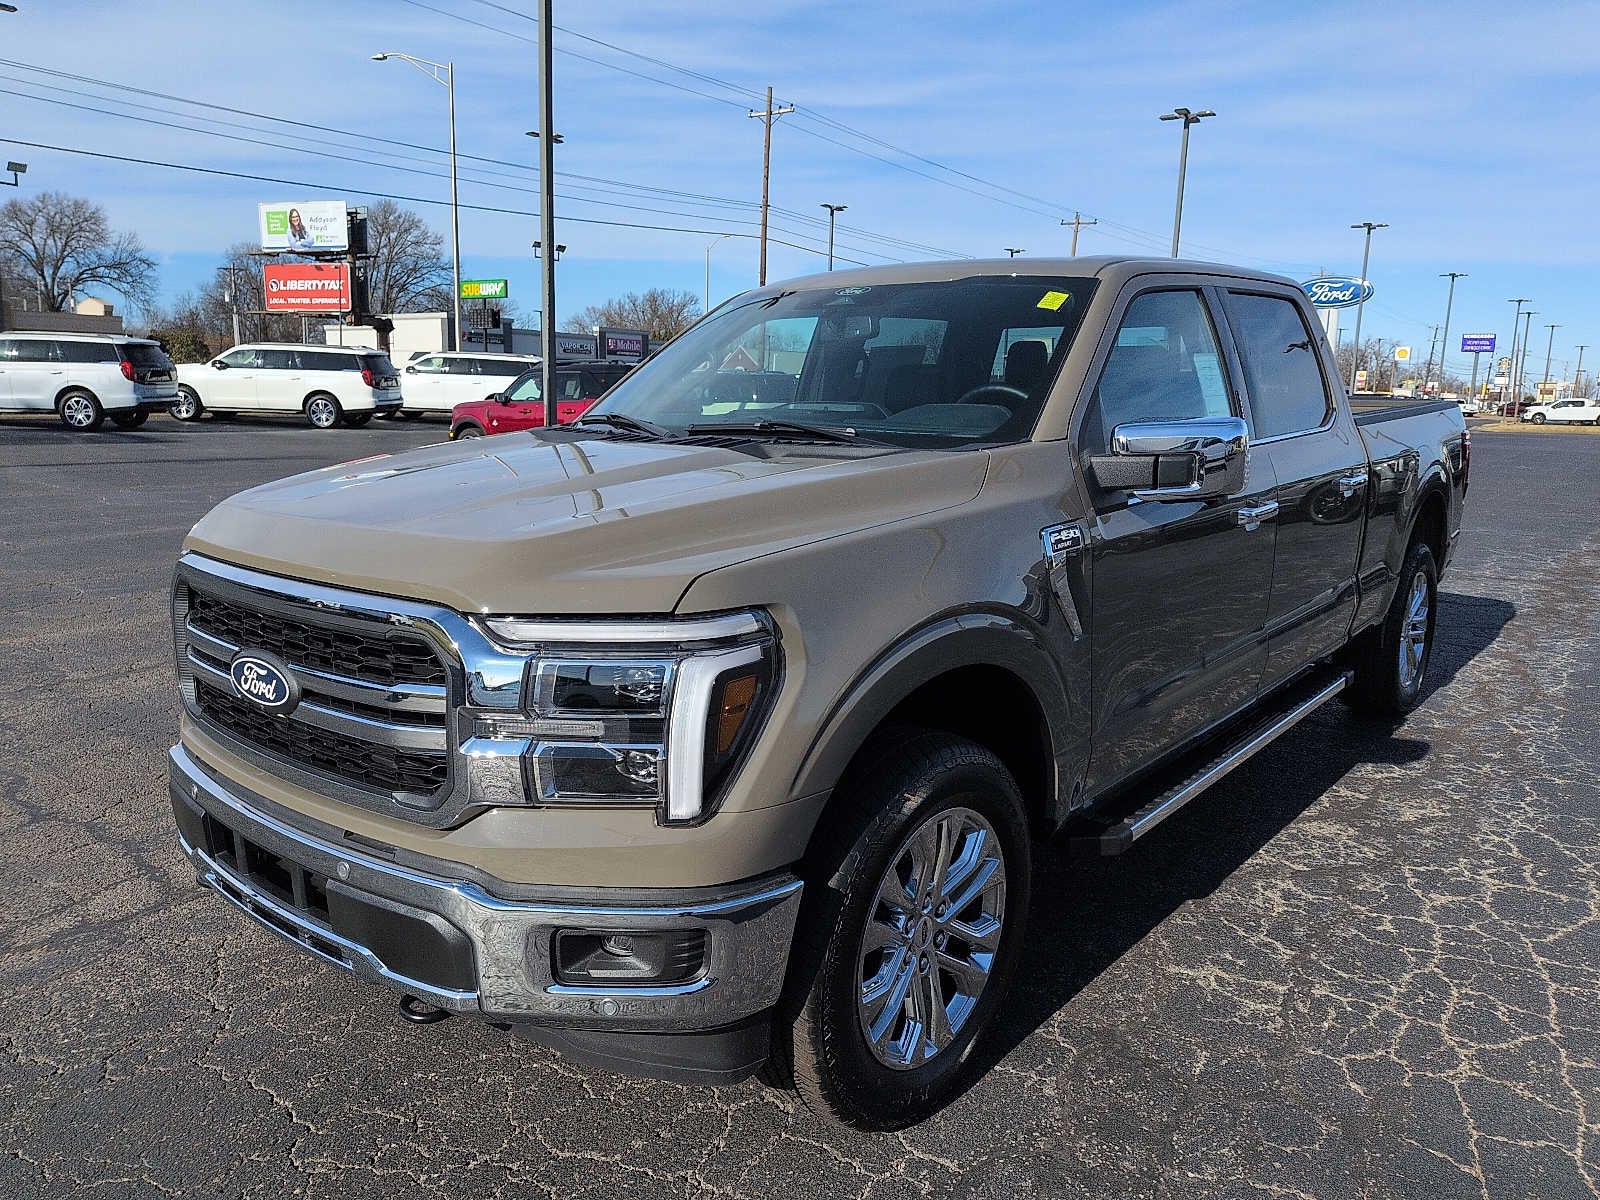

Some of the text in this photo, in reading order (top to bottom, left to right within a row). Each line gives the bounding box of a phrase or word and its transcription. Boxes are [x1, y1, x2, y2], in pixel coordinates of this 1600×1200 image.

[462, 282, 504, 297] SUBWAY
[1309, 283, 1353, 302] Ford
[241, 663, 276, 700] Ford
